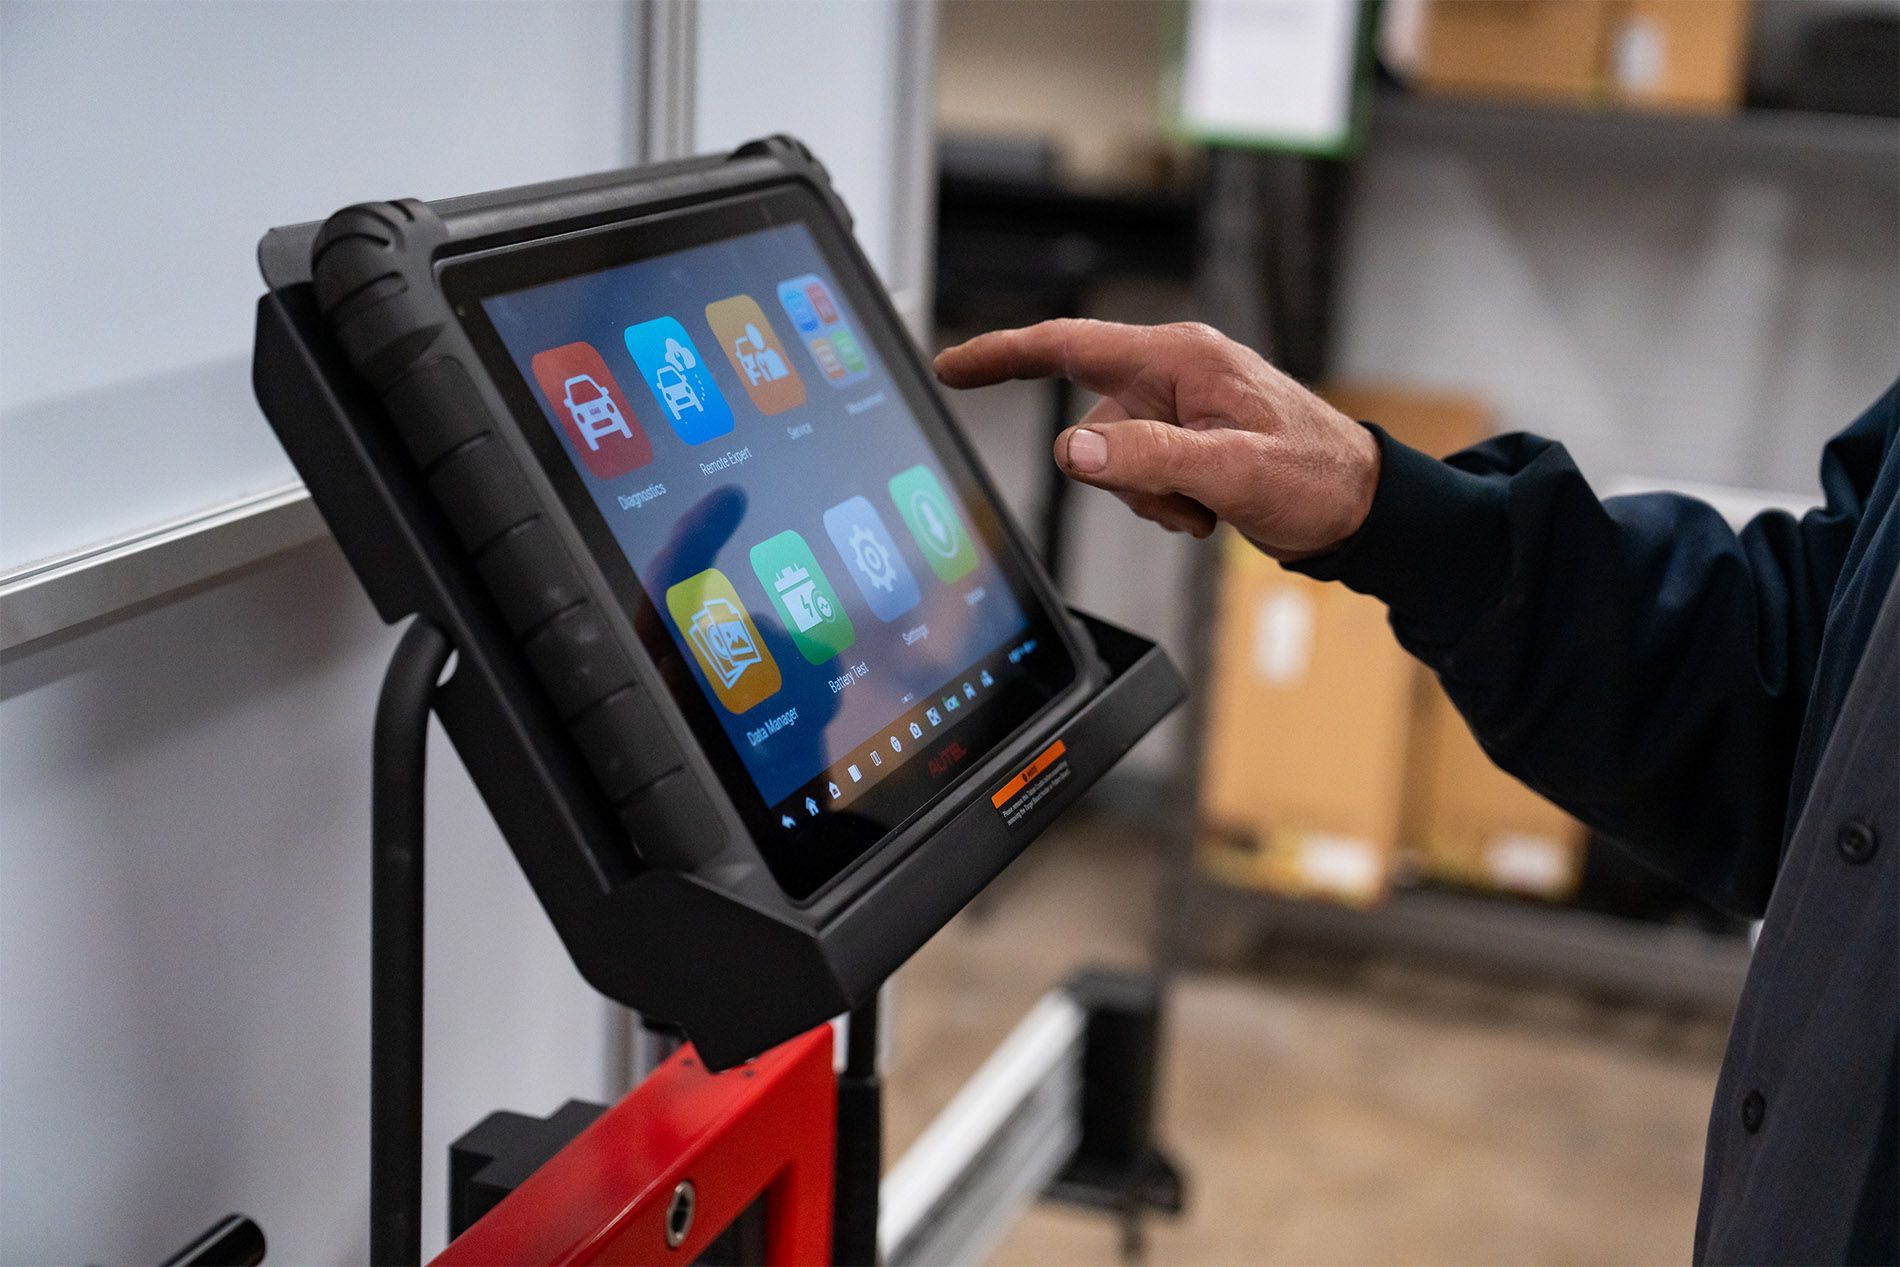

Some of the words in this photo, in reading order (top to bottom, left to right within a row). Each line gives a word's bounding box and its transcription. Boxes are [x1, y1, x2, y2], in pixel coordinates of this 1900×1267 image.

[699, 455, 730, 477] Remote
[727, 446, 753, 465] Expert
[618, 483, 667, 511] Diagnostics
[828, 671, 856, 694] Battery
[851, 661, 870, 679] Test
[746, 726, 769, 747] Data
[764, 707, 799, 735] Manager
